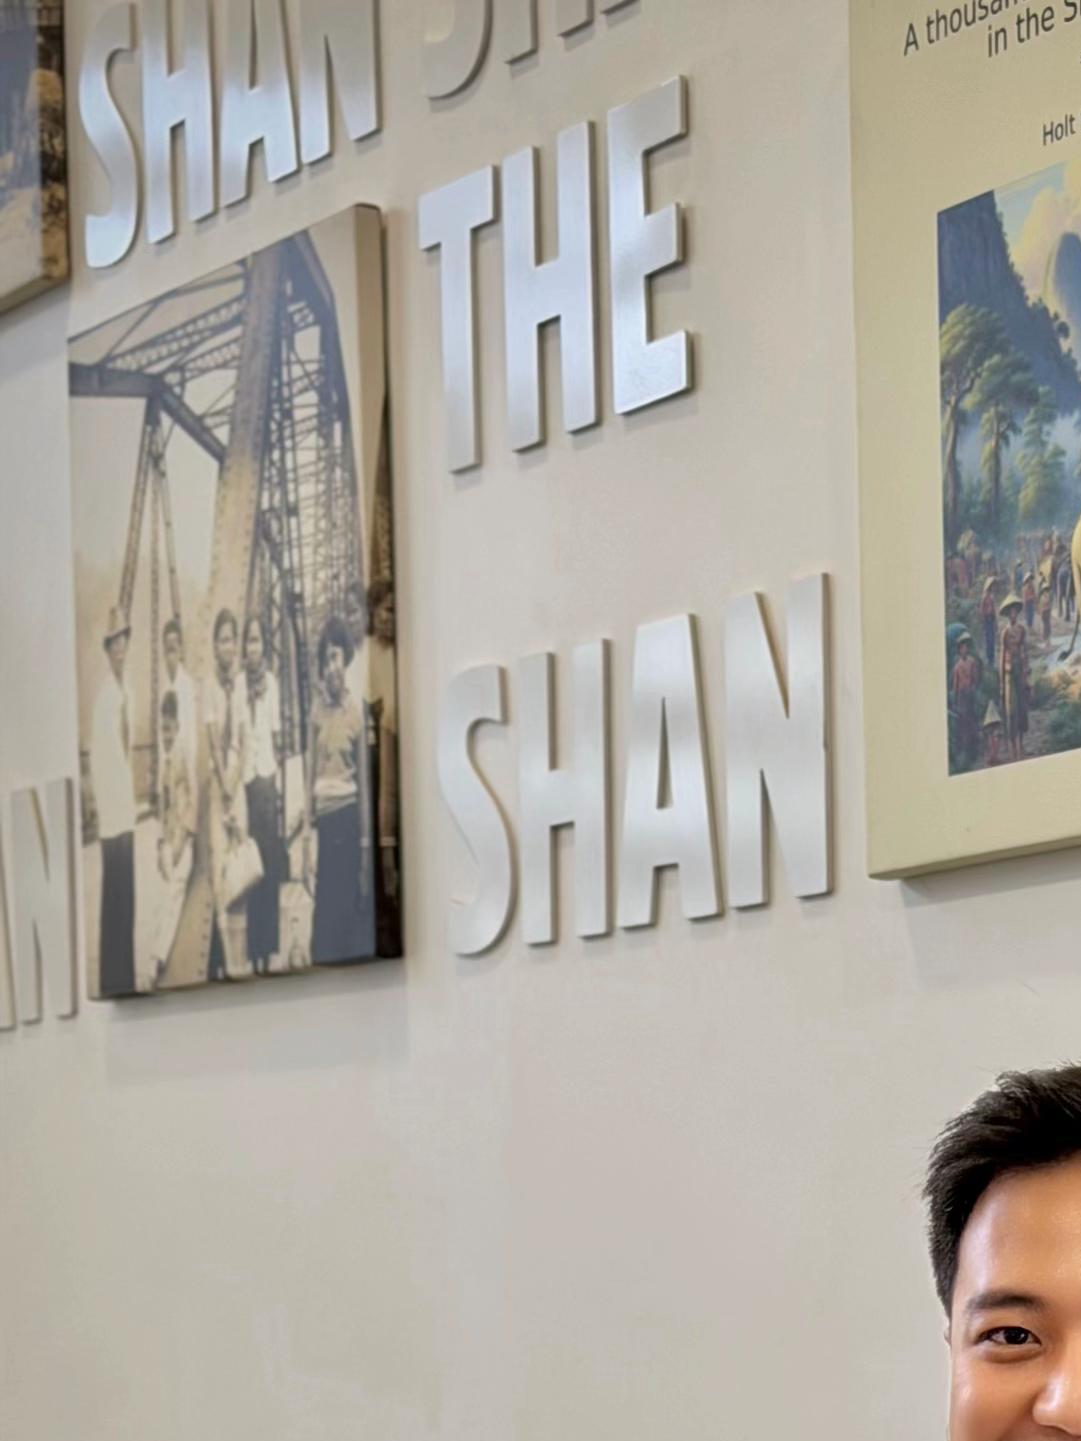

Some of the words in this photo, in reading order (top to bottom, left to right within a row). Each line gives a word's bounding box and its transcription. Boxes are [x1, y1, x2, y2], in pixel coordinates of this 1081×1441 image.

[904, 23, 919, 56] A
[988, 25, 1007, 57] in
[1016, 7, 1055, 43] the
[78, 0, 382, 269] SHAN
[1042, 113, 1076, 146] Holt
[418, 74, 690, 473] THE
[438, 572, 834, 957] SHAN
